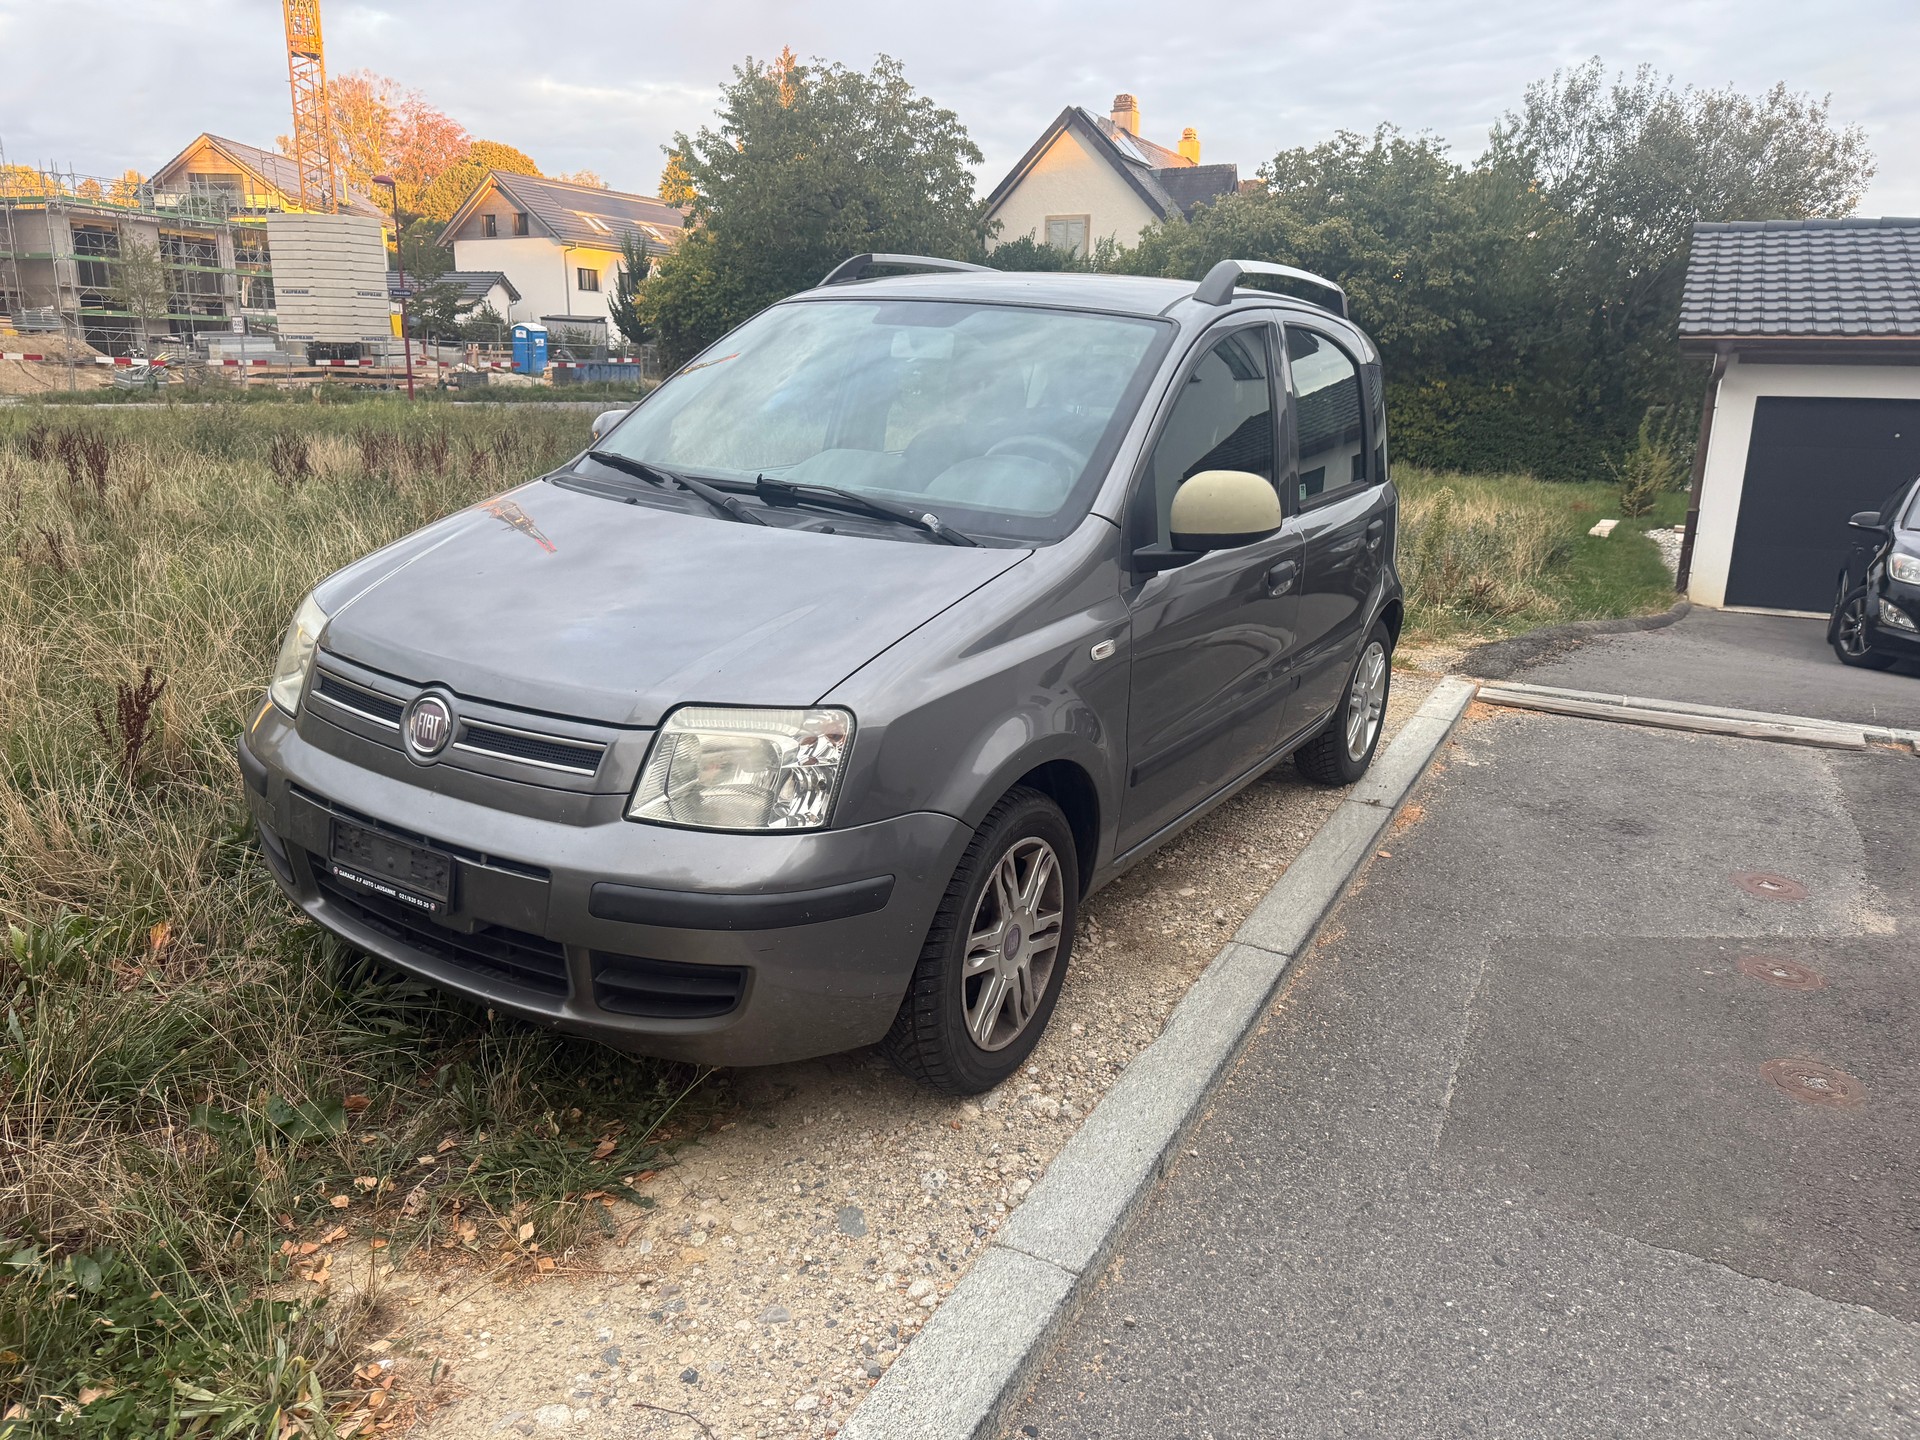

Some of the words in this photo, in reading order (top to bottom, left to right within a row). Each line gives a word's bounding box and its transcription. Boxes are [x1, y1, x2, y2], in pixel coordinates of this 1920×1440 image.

[416, 712, 442, 741] FIAT
[339, 869, 356, 881] GARAGE
[362, 879, 374, 888] AUTO
[374, 883, 396, 896] LAUSANNE
